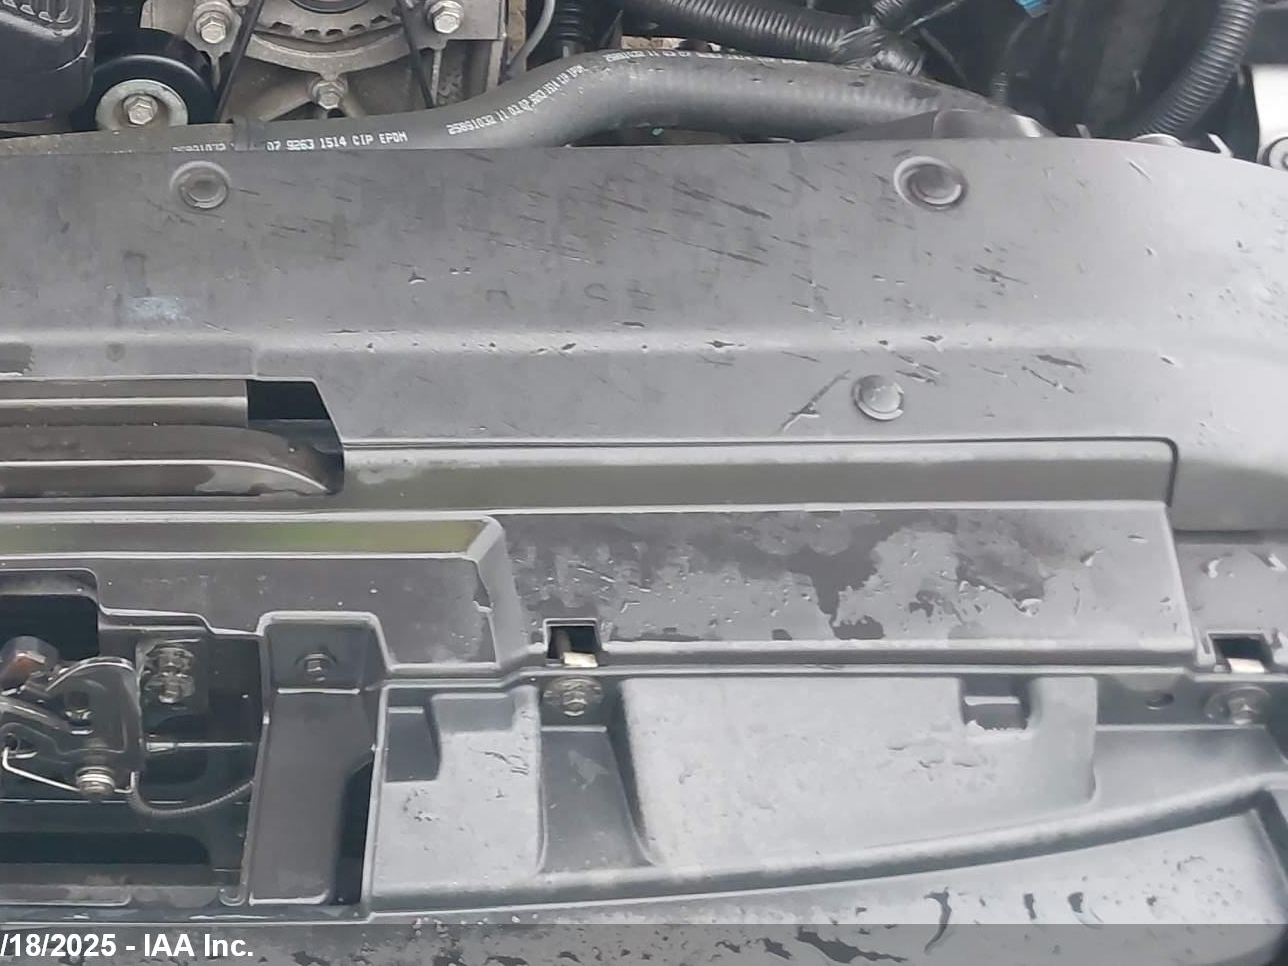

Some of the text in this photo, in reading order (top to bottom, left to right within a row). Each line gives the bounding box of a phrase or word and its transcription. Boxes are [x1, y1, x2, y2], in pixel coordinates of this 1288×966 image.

[266, 140, 282, 152] 07
[286, 137, 316, 151] 9263
[319, 135, 348, 149] 1514
[352, 133, 375, 146] CIP
